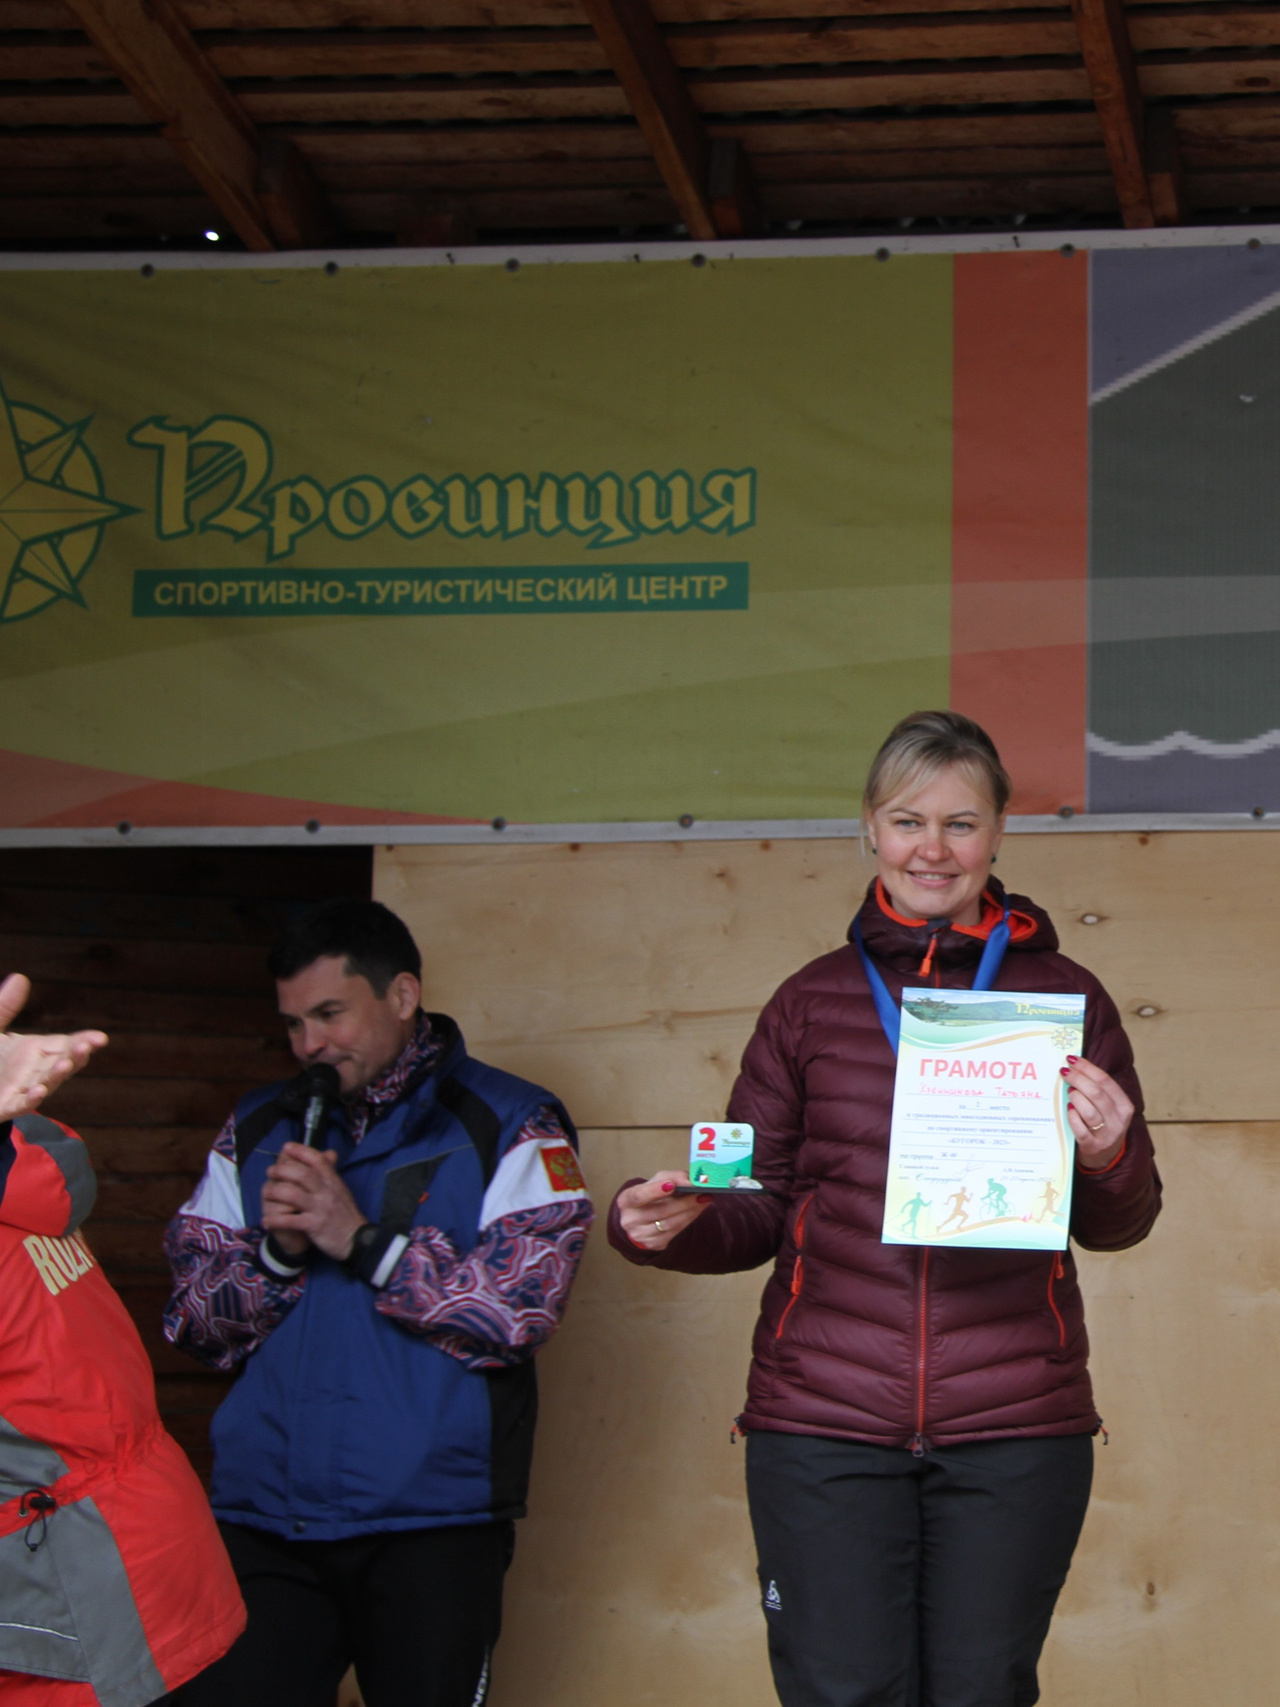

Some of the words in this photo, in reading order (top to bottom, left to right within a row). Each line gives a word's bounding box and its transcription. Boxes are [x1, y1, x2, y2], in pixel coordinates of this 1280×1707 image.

[127, 414, 758, 563] Провинция
[154, 573, 617, 605] СПОРТИВНО-ТУРИСТИЧЕСКИЙ
[627, 575, 728, 604] ЦЕНТР
[919, 1058, 1038, 1080] ГРАМОТА
[698, 1127, 717, 1150] 2
